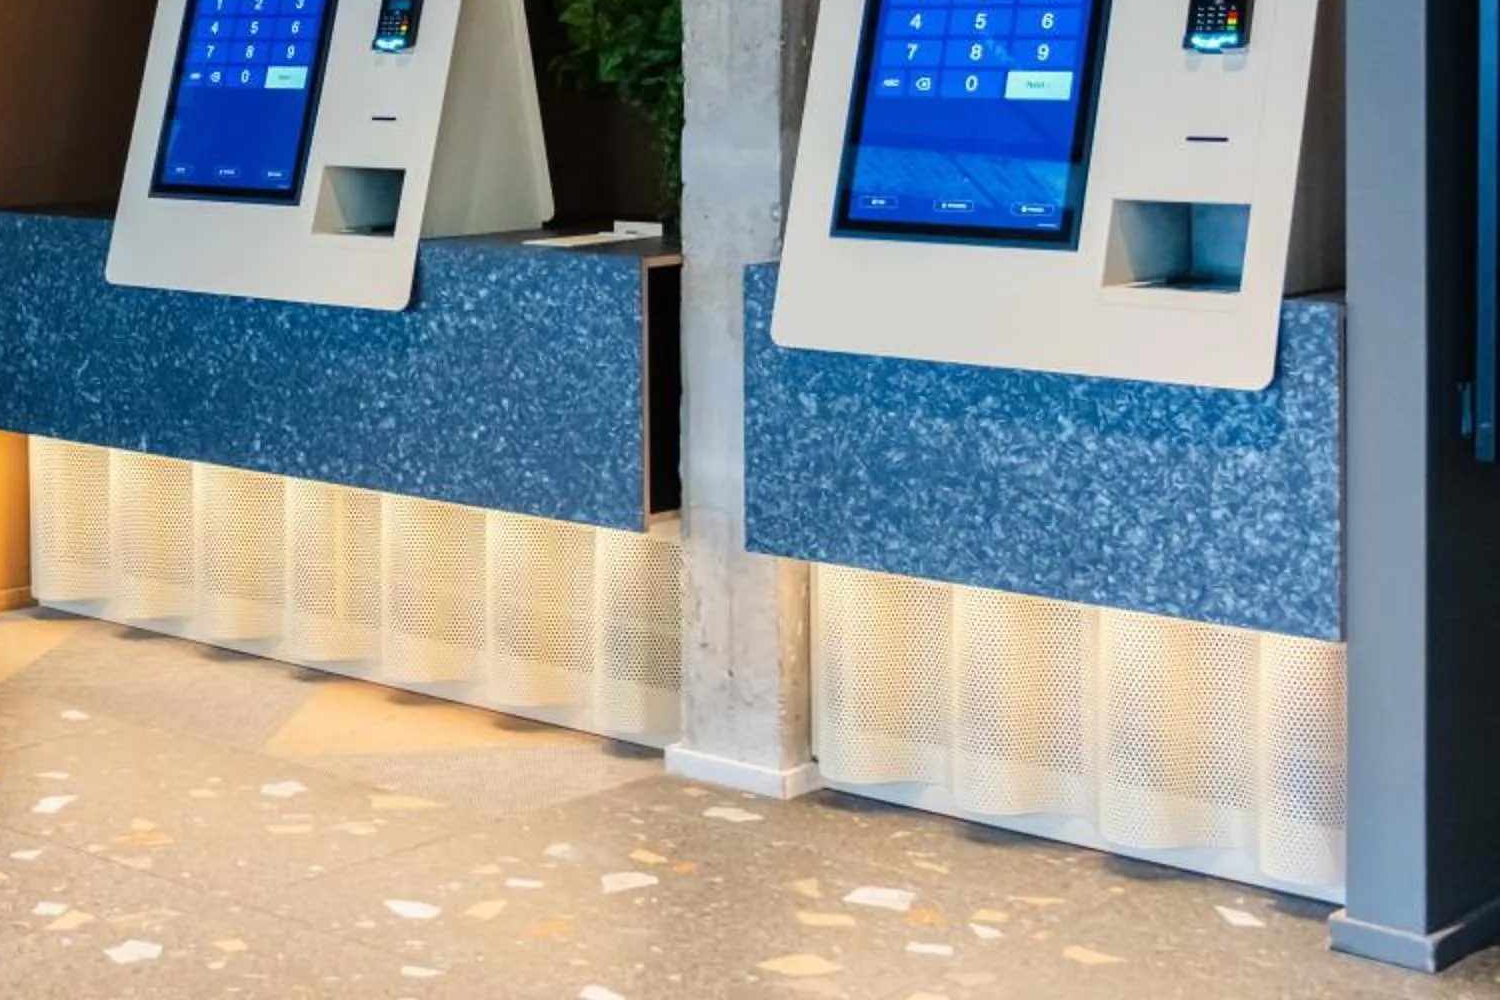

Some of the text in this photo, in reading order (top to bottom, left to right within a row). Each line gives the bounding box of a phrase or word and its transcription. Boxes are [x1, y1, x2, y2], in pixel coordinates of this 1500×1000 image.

[211, 20, 300, 34] 4 5 6
[909, 12, 1054, 30] 4 5 6
[206, 45, 295, 59] 7 8 9
[907, 43, 1050, 61] 7 8 9
[240, 69, 250, 83] 0
[965, 75, 979, 92] 0
